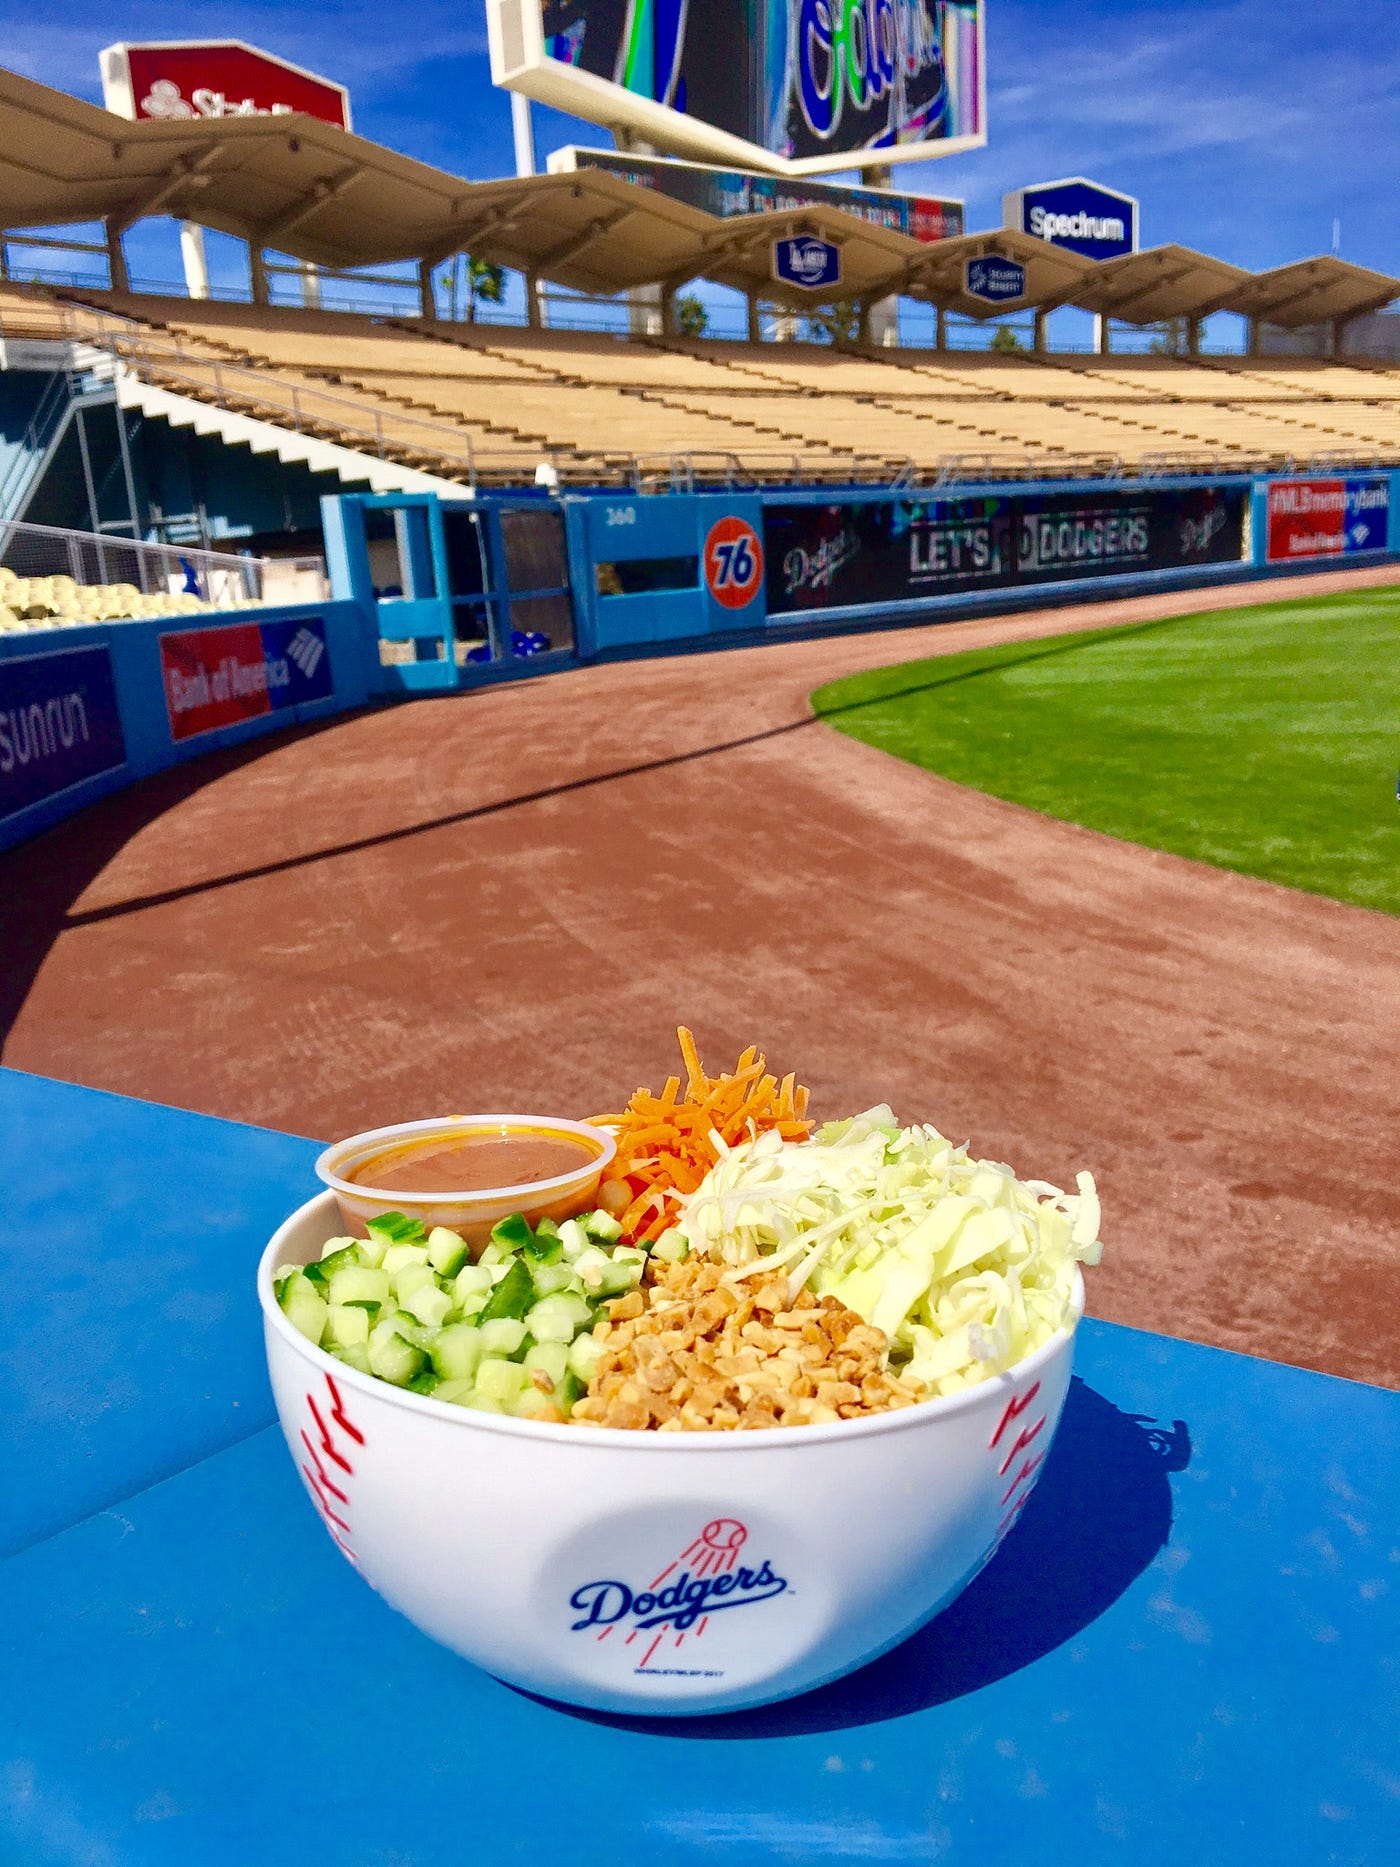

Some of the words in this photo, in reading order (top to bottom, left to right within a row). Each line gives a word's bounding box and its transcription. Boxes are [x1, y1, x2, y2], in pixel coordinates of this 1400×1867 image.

[1030, 206, 1124, 242] Spectrum
[714, 536, 755, 587] 76
[910, 527, 989, 572] LET'S
[1040, 517, 1149, 560] DODGERS
[0, 693, 89, 772] sunrun
[570, 1560, 787, 1631] Dodgers
